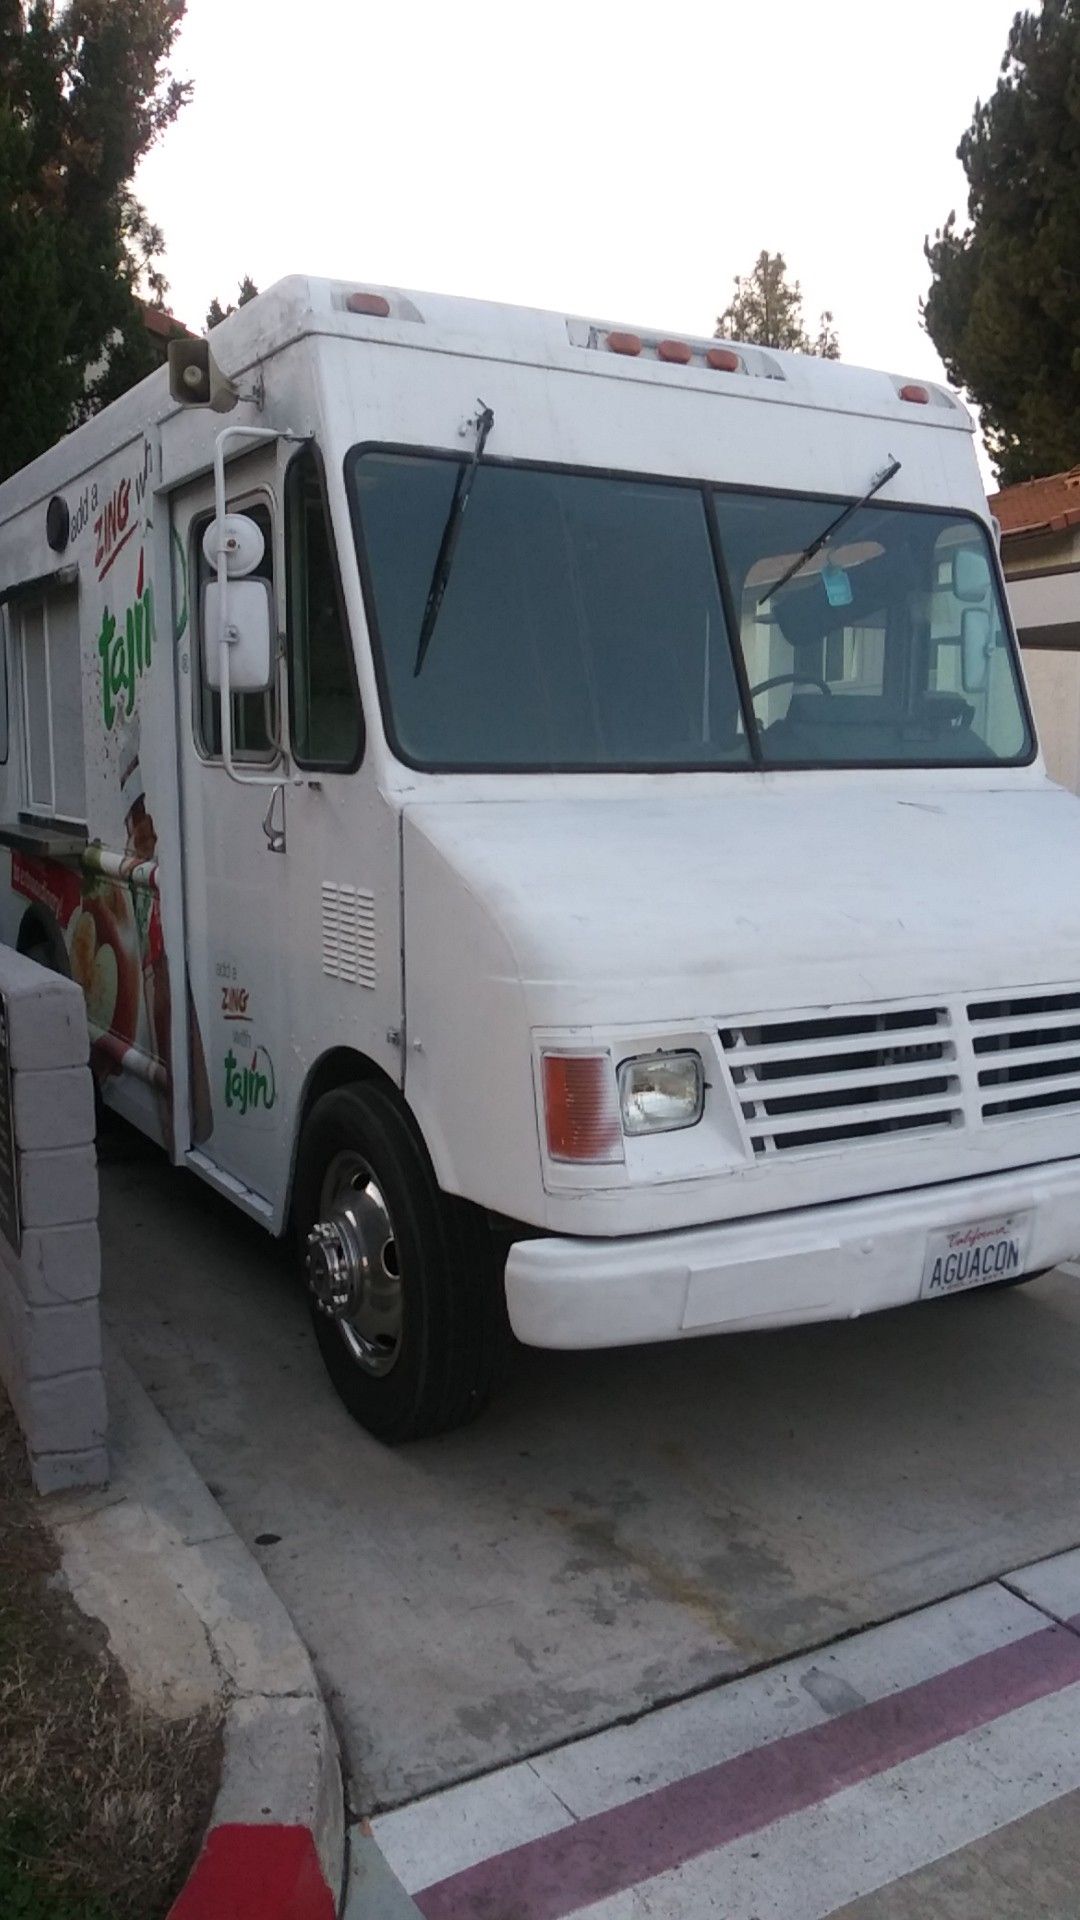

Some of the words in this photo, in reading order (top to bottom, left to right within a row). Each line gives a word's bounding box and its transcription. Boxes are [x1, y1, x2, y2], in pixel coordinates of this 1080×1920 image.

[70, 486, 89, 543] add
[91, 482, 98, 511] a
[94, 478, 131, 568] ZING
[929, 1240, 1019, 1289] AGUACON
